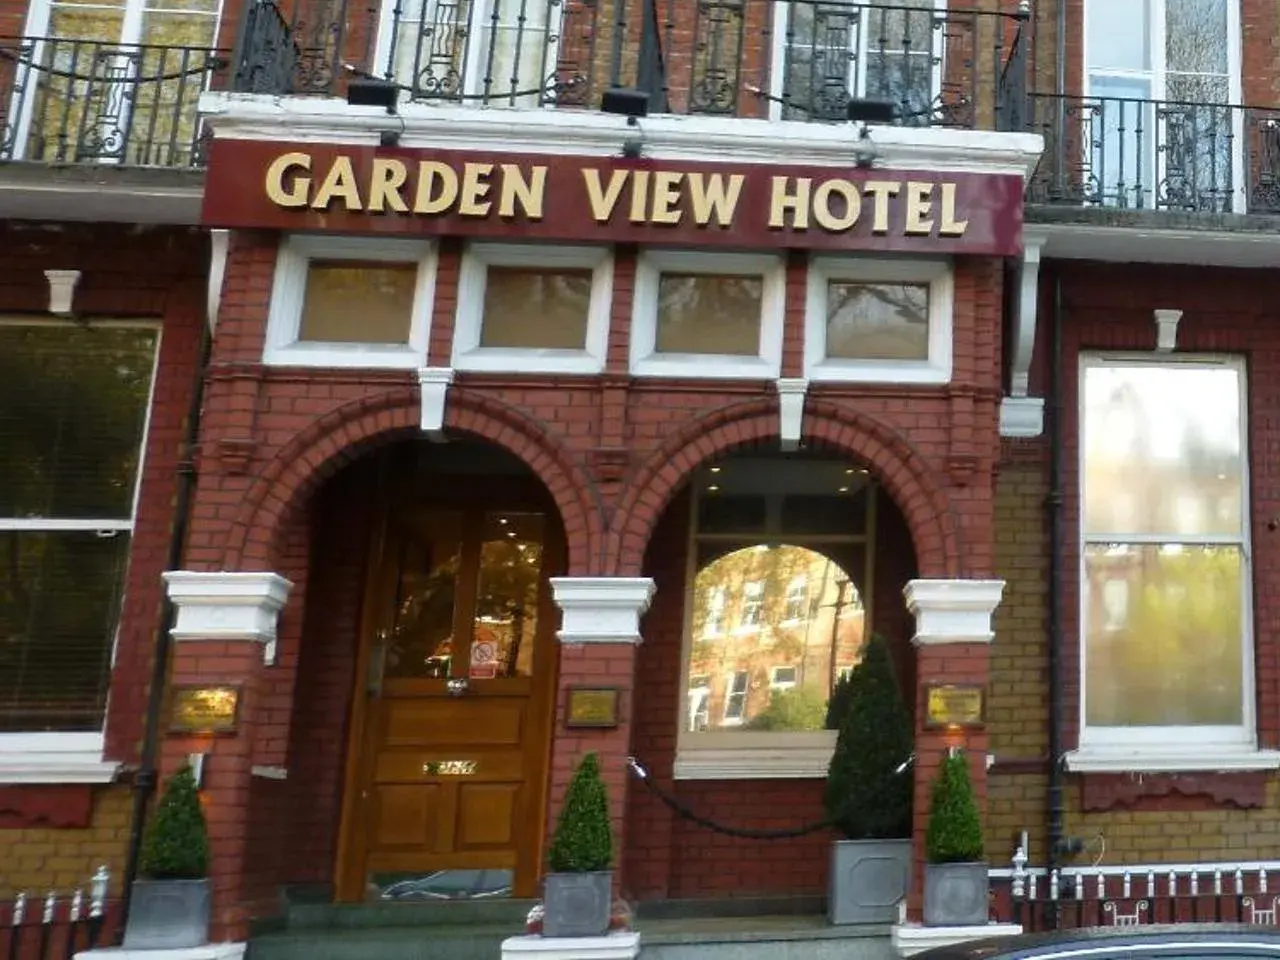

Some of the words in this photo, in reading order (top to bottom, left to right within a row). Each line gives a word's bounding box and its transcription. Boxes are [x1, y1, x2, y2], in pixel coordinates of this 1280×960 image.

[265, 152, 548, 219] GARDEN
[582, 169, 745, 226] VIEW
[768, 175, 968, 236] HOTEL
